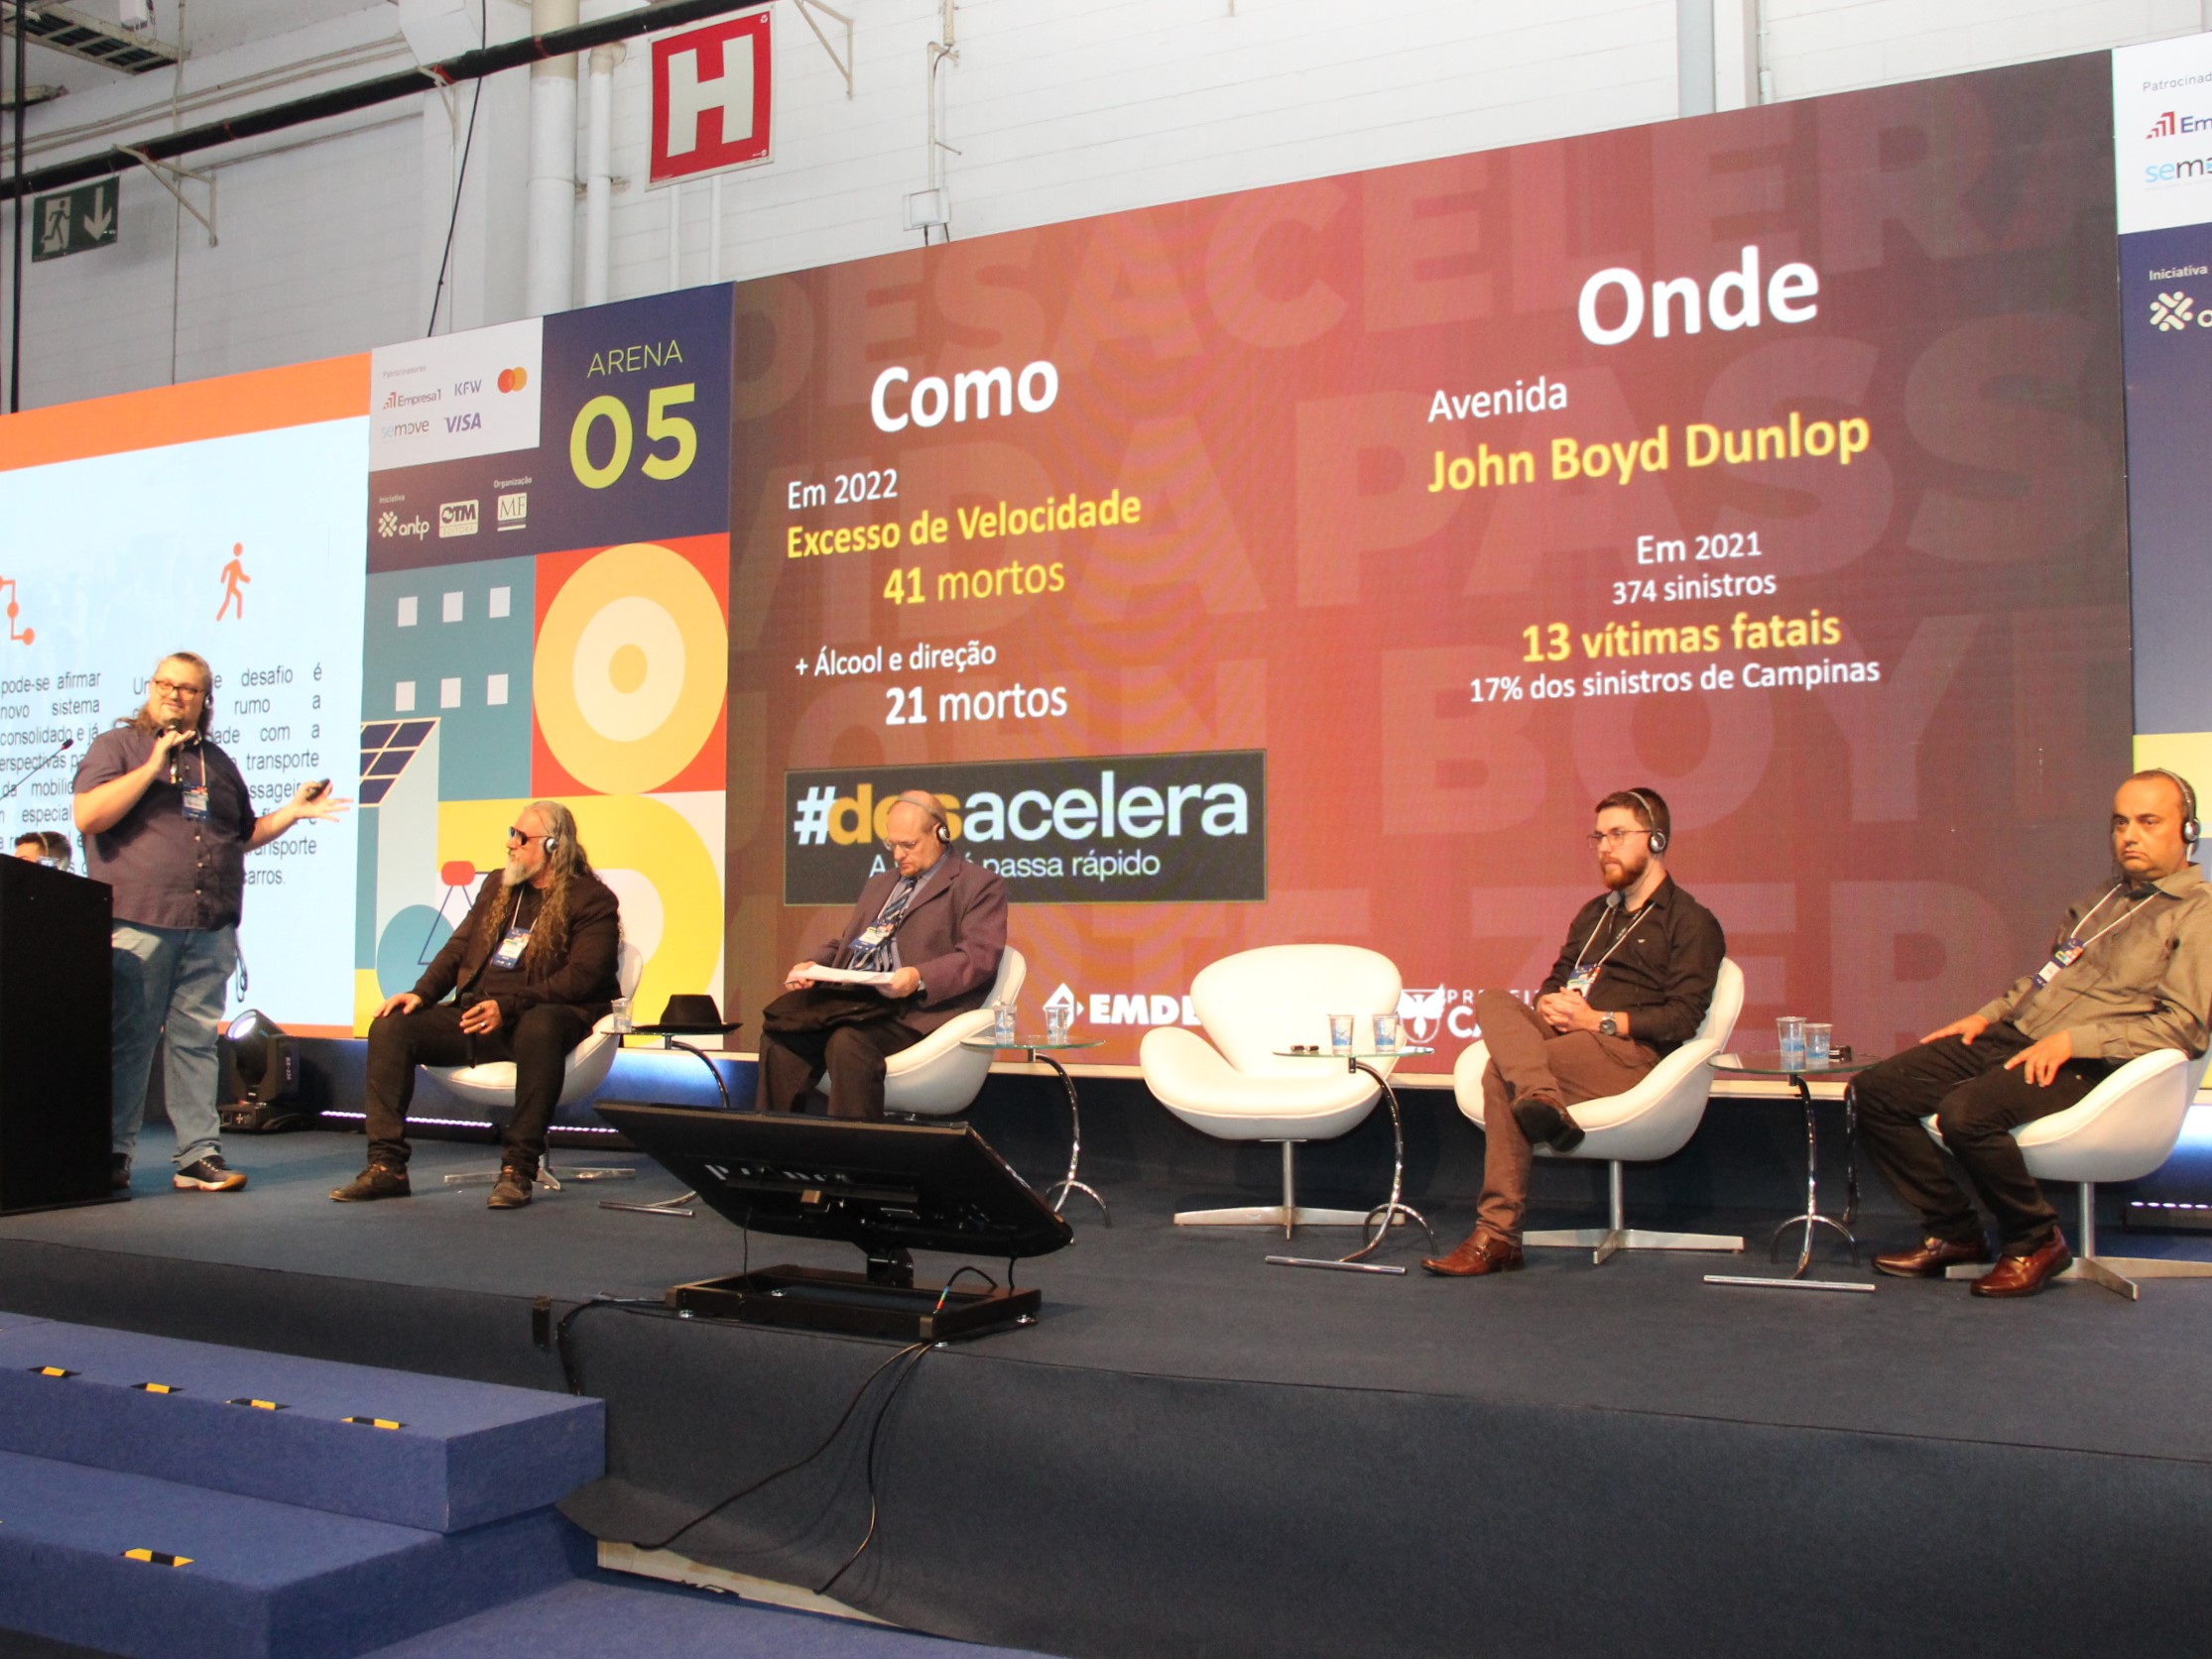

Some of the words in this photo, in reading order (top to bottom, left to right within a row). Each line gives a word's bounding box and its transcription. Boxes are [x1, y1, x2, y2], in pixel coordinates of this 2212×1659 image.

[667, 34, 754, 158] H
[2149, 265, 2208, 282] Iniciativa
[1578, 245, 1819, 345] Onde
[587, 339, 683, 378] ARENA
[870, 360, 1058, 432] Como
[1427, 375, 1568, 422] Avenida
[381, 420, 430, 438] semove
[444, 413, 482, 433] VISA
[569, 383, 697, 489] 05
[1427, 443, 1536, 493] John
[1551, 424, 1668, 485] Boyd
[1686, 412, 1871, 466] Dunlop
[494, 476, 533, 489] Organização
[788, 481, 825, 510] Em
[834, 468, 899, 505] 2022
[379, 495, 406, 504] Iniciativa
[499, 495, 526, 519] MF
[398, 515, 430, 541] antp
[787, 522, 900, 558] Excesso
[910, 510, 948, 545] de
[957, 488, 1142, 540] Velocidade
[1637, 535, 1685, 564] Em
[1695, 532, 1762, 561] 2021
[883, 567, 925, 605] 41
[937, 560, 1065, 601] mortos
[1612, 579, 1657, 605] 374
[1663, 572, 1777, 602] sinistros
[1522, 623, 1571, 662] 13
[1582, 621, 1721, 658] vítimas
[1731, 609, 1841, 651] fatais
[241, 665, 294, 687] desafio
[313, 662, 322, 681] é
[813, 646, 882, 677] Álcool
[889, 652, 903, 672] e
[909, 640, 997, 673] direção
[1, 676, 50, 698] pode-se
[58, 671, 101, 690] afirmar
[1469, 675, 1524, 703] 17%
[1531, 674, 1576, 700] dos
[1582, 667, 1692, 697] sinistros
[1700, 664, 1734, 690] de
[1742, 658, 1881, 691] Campinas
[0, 704, 30, 720] novo
[52, 698, 100, 716] sistema
[234, 698, 271, 715] rumo
[312, 694, 320, 710] a
[885, 686, 926, 725] 21
[938, 682, 1067, 722] mortos
[0, 725, 72, 746] consolidado
[76, 727, 84, 742] e
[260, 725, 291, 742] com
[311, 724, 319, 739] a
[247, 748, 319, 773] transporte
[22, 803, 72, 825] especial
[244, 870, 286, 886] arros.
[982, 857, 1064, 879] passa
[1072, 849, 1162, 883] rápido
